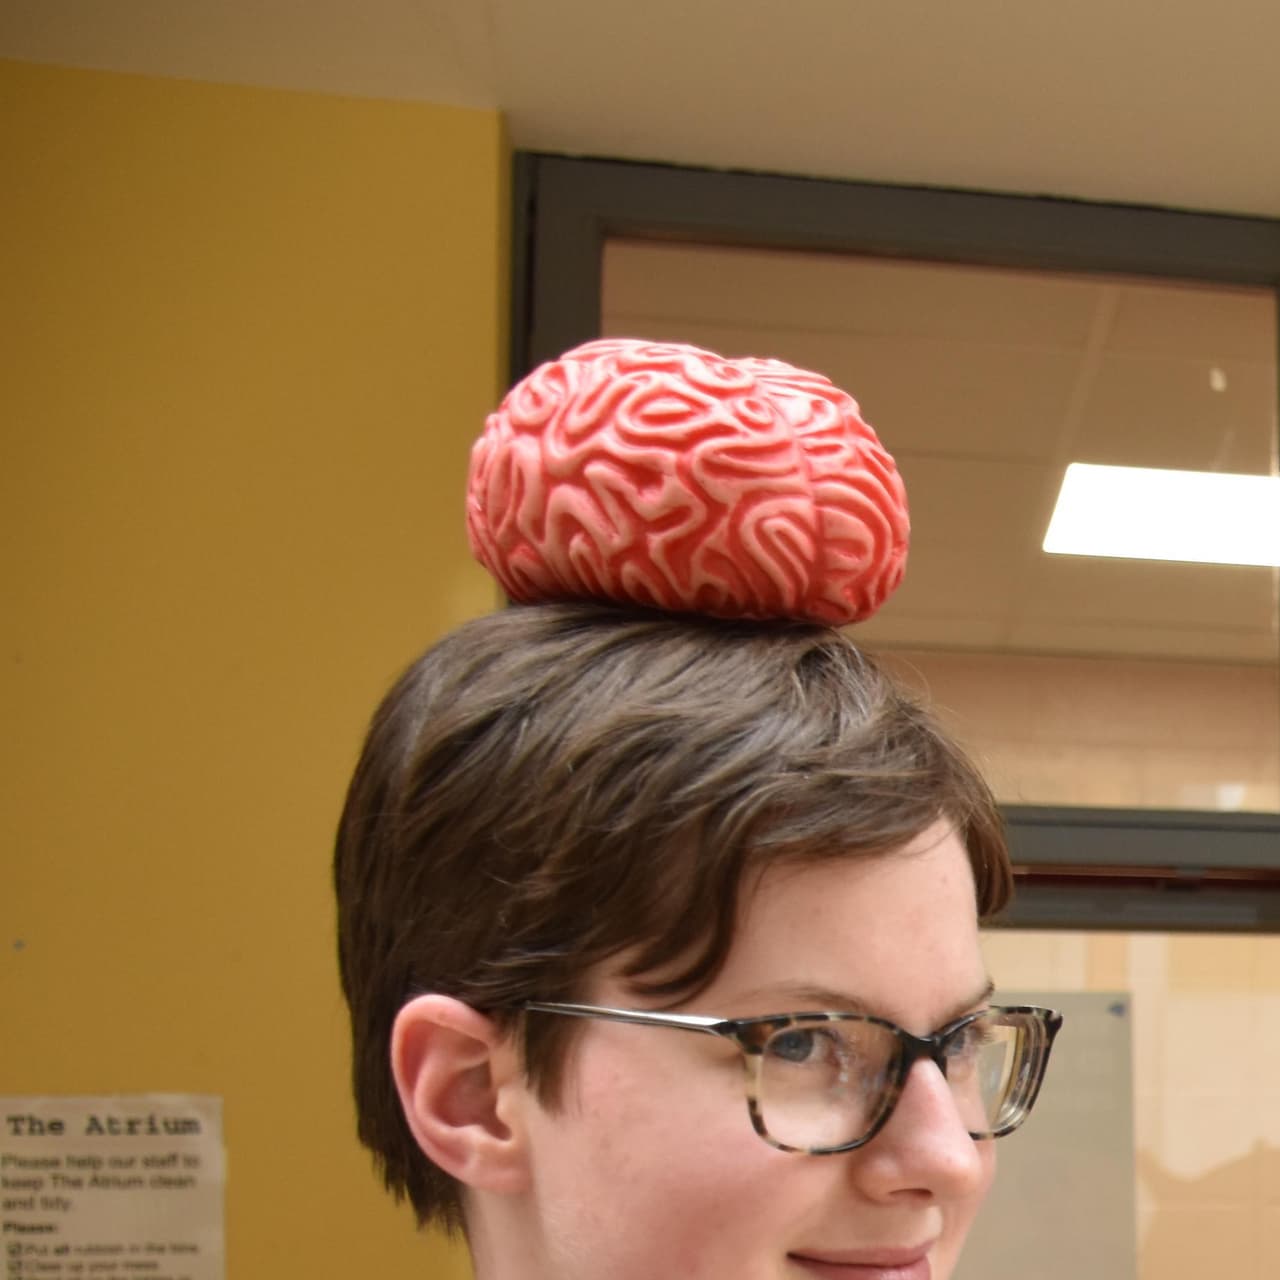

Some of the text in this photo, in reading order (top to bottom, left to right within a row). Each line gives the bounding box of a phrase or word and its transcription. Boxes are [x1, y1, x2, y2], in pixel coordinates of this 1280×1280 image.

[6, 1114, 201, 1136] The Atrium
[1, 1153, 200, 1171] Please help our staff to
[1, 1175, 195, 1192] keep The Atrium clean
[2, 1197, 35, 1210] and
